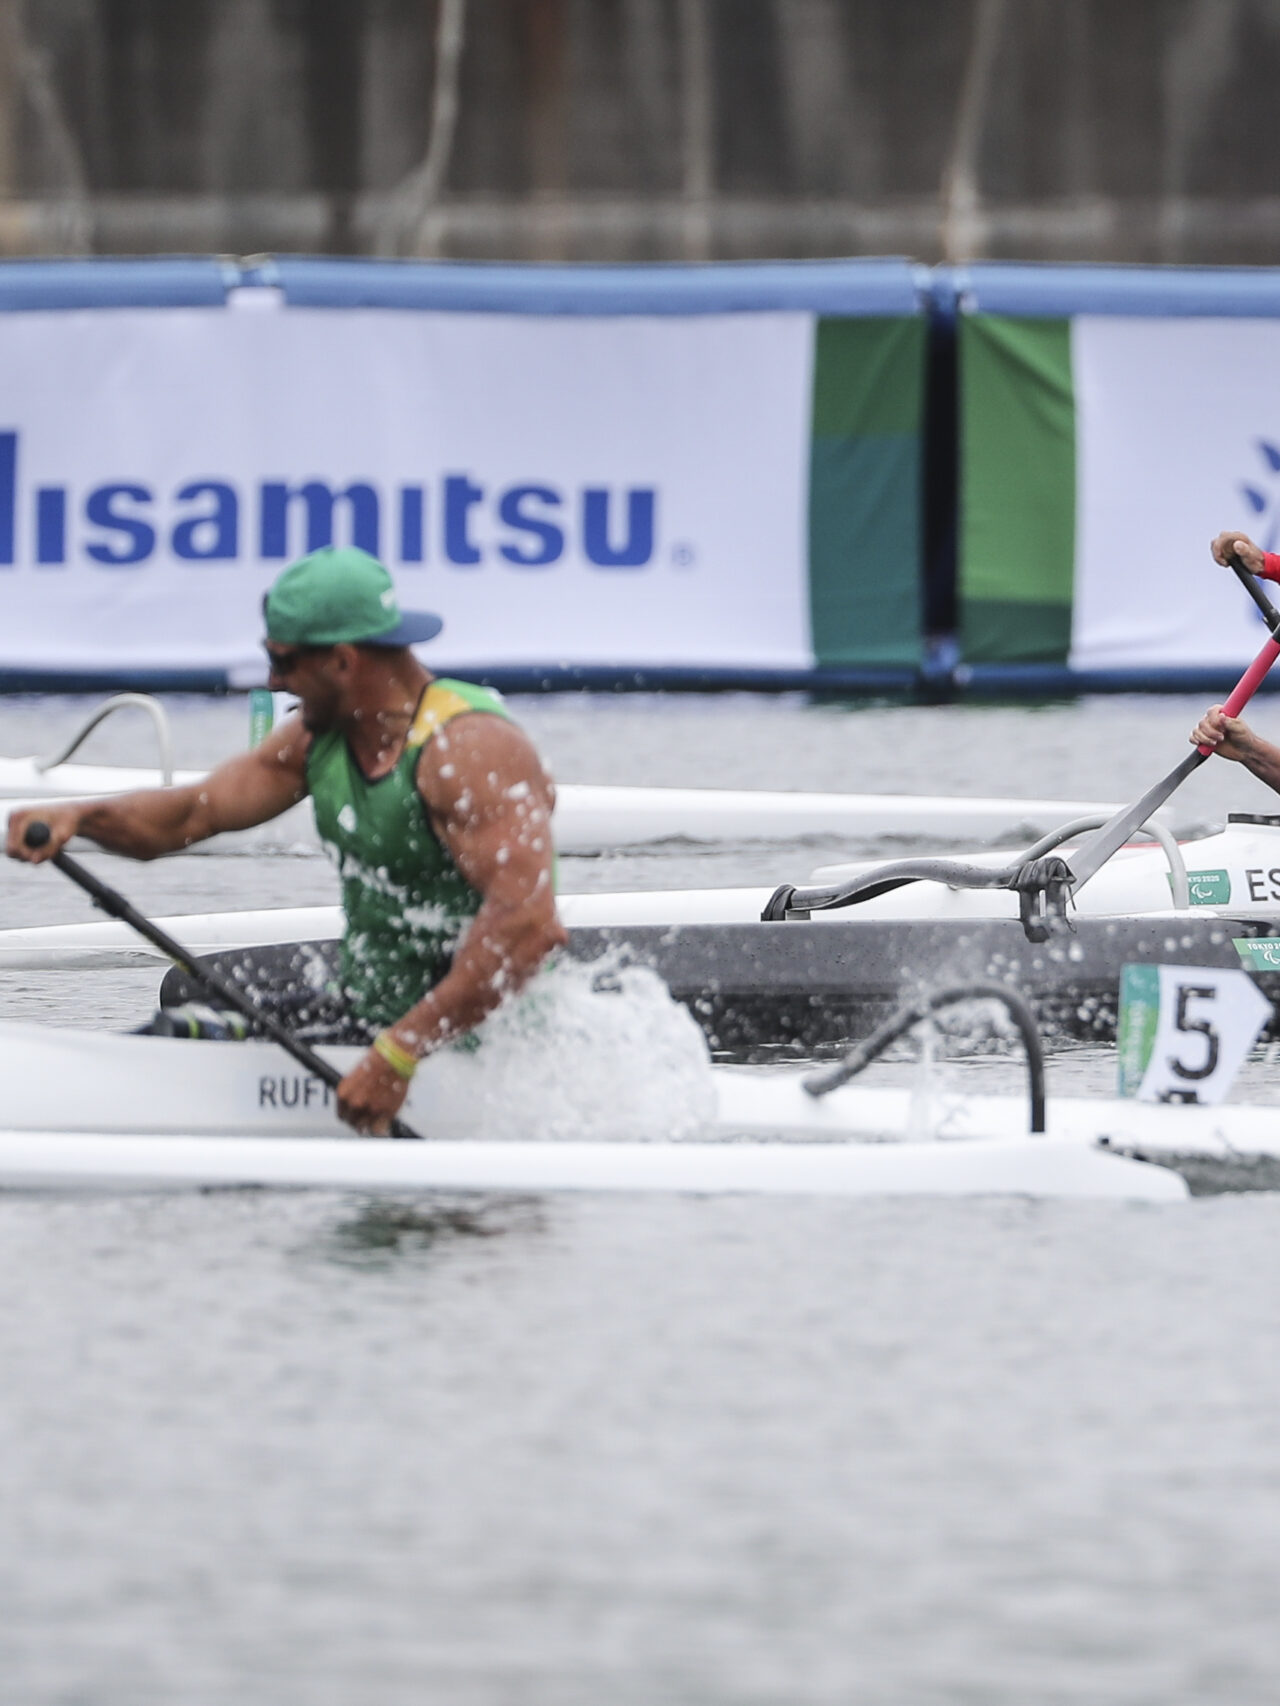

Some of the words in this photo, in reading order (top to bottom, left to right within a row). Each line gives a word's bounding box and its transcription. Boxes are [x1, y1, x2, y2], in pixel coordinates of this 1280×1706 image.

[0, 432, 656, 566] isamitsu
[1247, 943, 1273, 951] TOKYO
[1171, 986, 1219, 1080] 5
